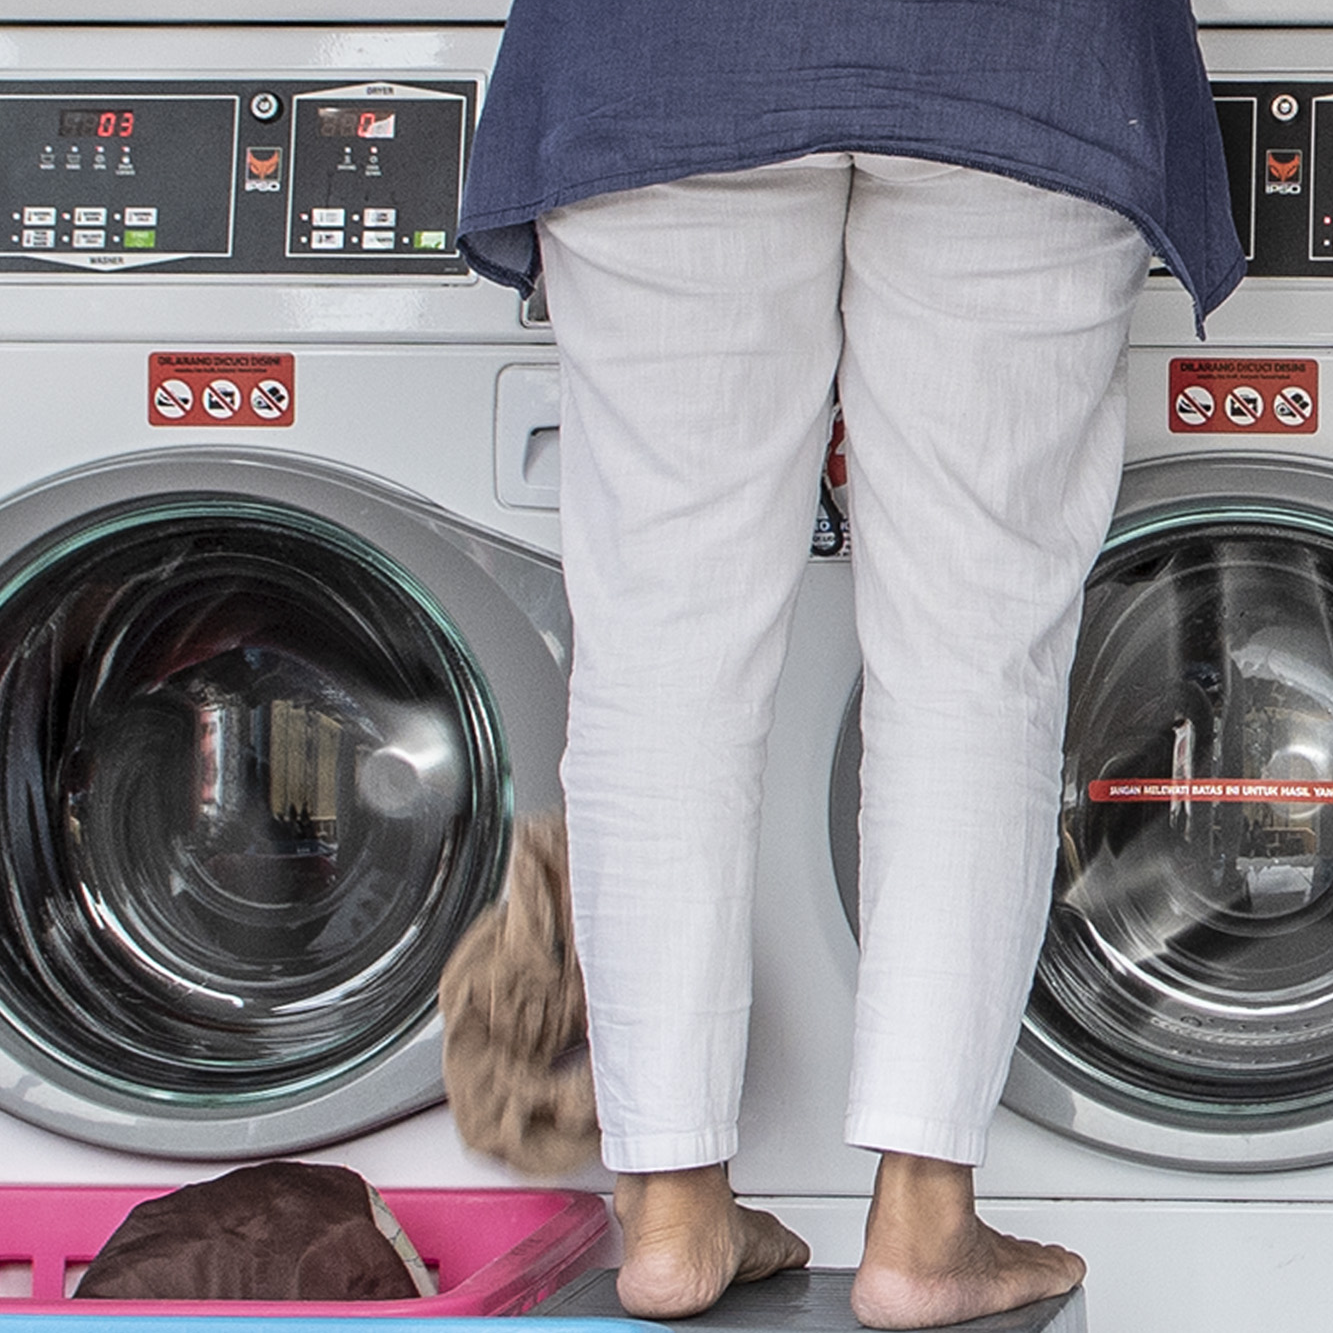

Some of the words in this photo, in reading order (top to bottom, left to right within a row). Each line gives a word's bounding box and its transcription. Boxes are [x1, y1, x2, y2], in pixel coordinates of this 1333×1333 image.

[96, 112, 135, 138] 03
[1191, 786, 1223, 798] BATAS
[1242, 787, 1278, 799] UNTUK
[1280, 788, 1311, 800] HASIL
